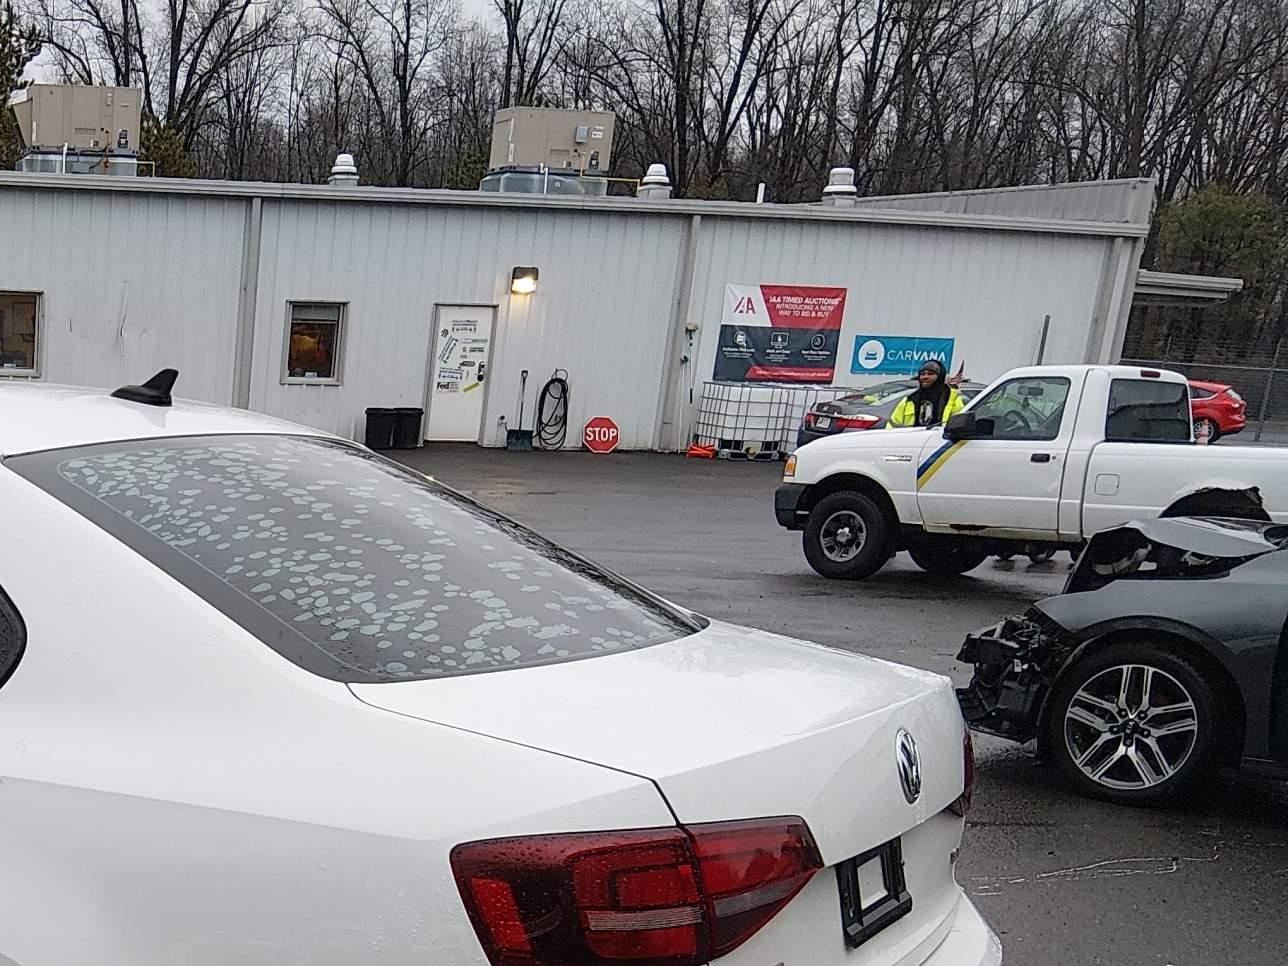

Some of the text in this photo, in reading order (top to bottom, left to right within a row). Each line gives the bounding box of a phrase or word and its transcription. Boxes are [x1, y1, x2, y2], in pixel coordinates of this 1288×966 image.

[782, 296, 803, 304] TIMED
[887, 349, 946, 362] CARVANA
[585, 427, 617, 442] STOP
